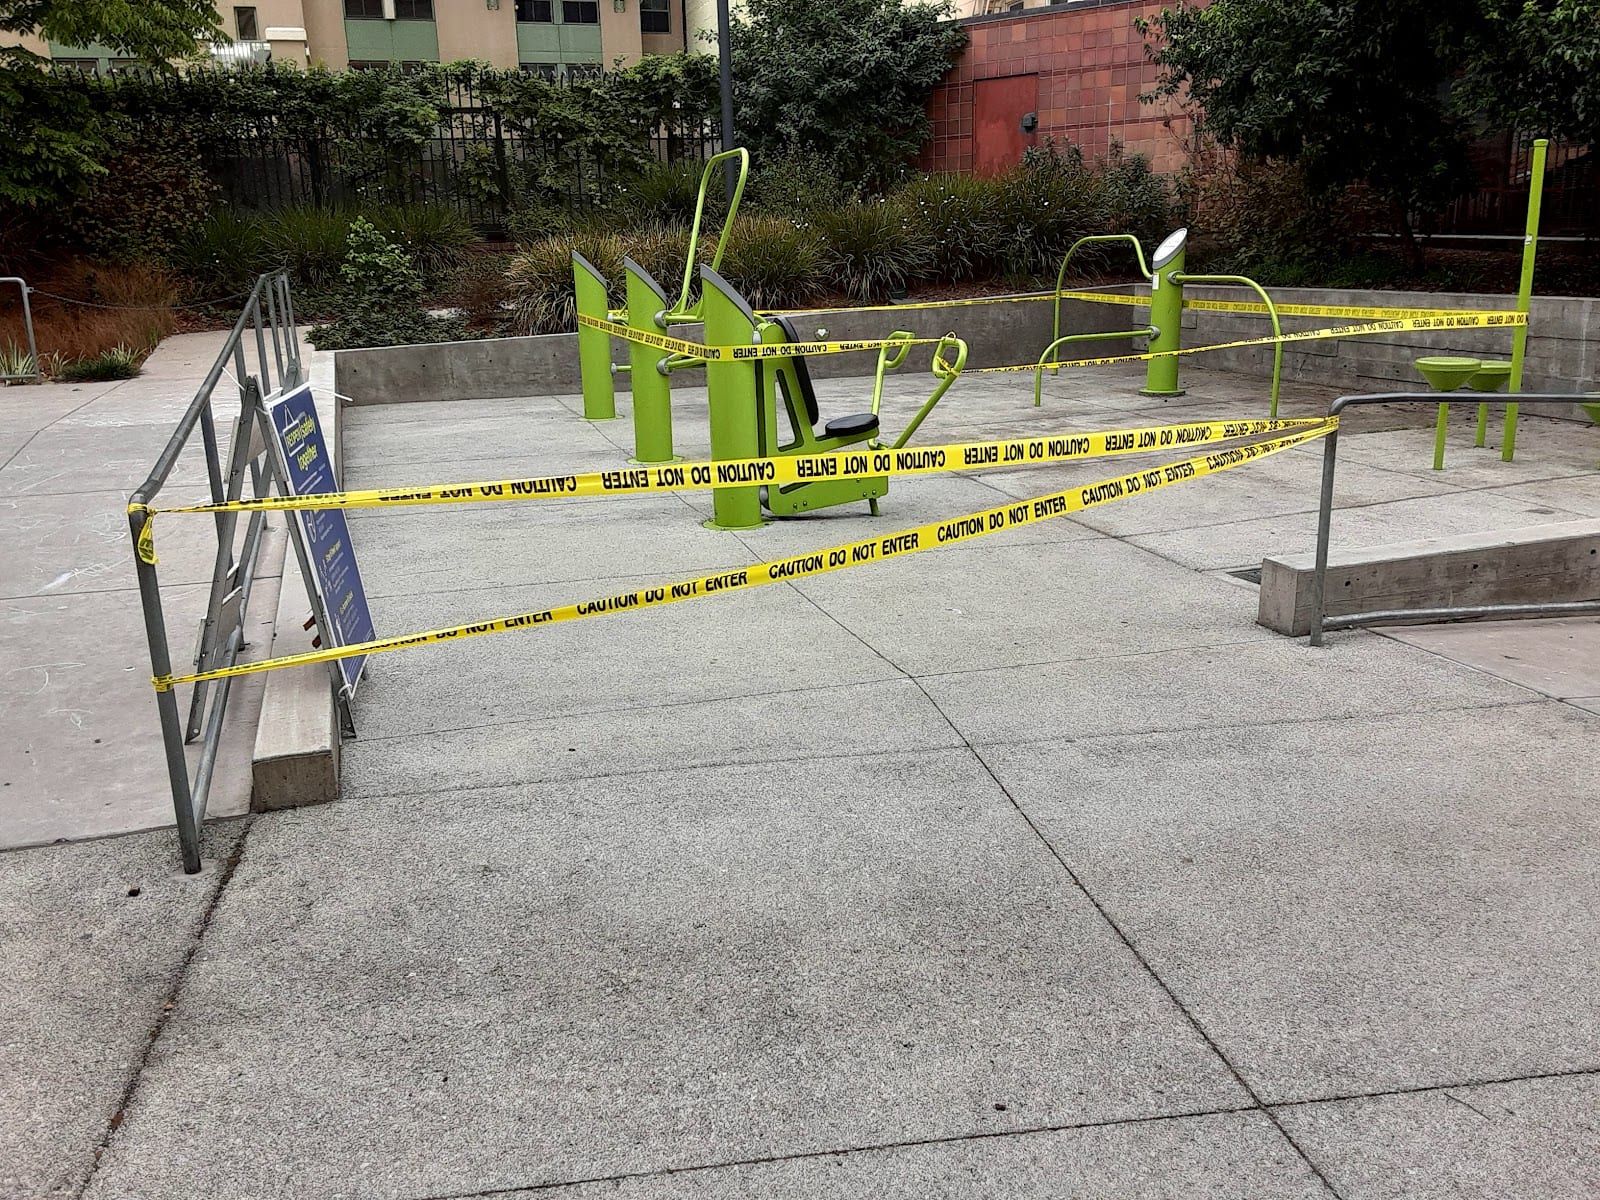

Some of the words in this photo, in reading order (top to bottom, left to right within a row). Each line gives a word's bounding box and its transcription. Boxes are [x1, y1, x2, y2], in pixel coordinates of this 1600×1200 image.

[732, 348, 758, 358] ENTER
[762, 347, 777, 357] NOT
[794, 344, 827, 354] CAUTION
[1105, 433, 1134, 451] ENTER
[1138, 431, 1157, 448] NOT
[1159, 429, 1173, 445] DO
[1176, 425, 1212, 443] CAUTION
[964, 445, 998, 464] ENTER
[1003, 443, 1024, 462] NOT
[1029, 441, 1043, 459] DO
[1048, 437, 1090, 457] CAUTION
[796, 457, 837, 477] ENTER
[843, 455, 868, 475] NOT
[874, 454, 890, 472] DO
[896, 449, 946, 471] CAUTION
[1206, 449, 1244, 471] CAUTION
[601, 470, 649, 489] ENTER
[656, 467, 685, 487] NOT
[691, 466, 710, 485] DO
[717, 461, 775, 483] CAUTION
[510, 475, 577, 494] CAUTION
[1081, 481, 1124, 505] CAUTION
[1127, 477, 1141, 492] DO
[1144, 470, 1162, 488] NOT
[1165, 462, 1195, 481] ENTER
[937, 518, 984, 542] CAUTION
[989, 511, 1004, 529] DO
[1009, 505, 1029, 525] NOT
[1034, 496, 1067, 518] ENTER
[769, 555, 823, 579] CAUTION
[829, 550, 846, 567] DO
[852, 543, 877, 562] NOT
[882, 533, 919, 555] ENTER
[576, 593, 638, 615] CAUTION
[645, 588, 664, 603] DO
[672, 581, 699, 598] NOT
[705, 571, 748, 591] ENTER
